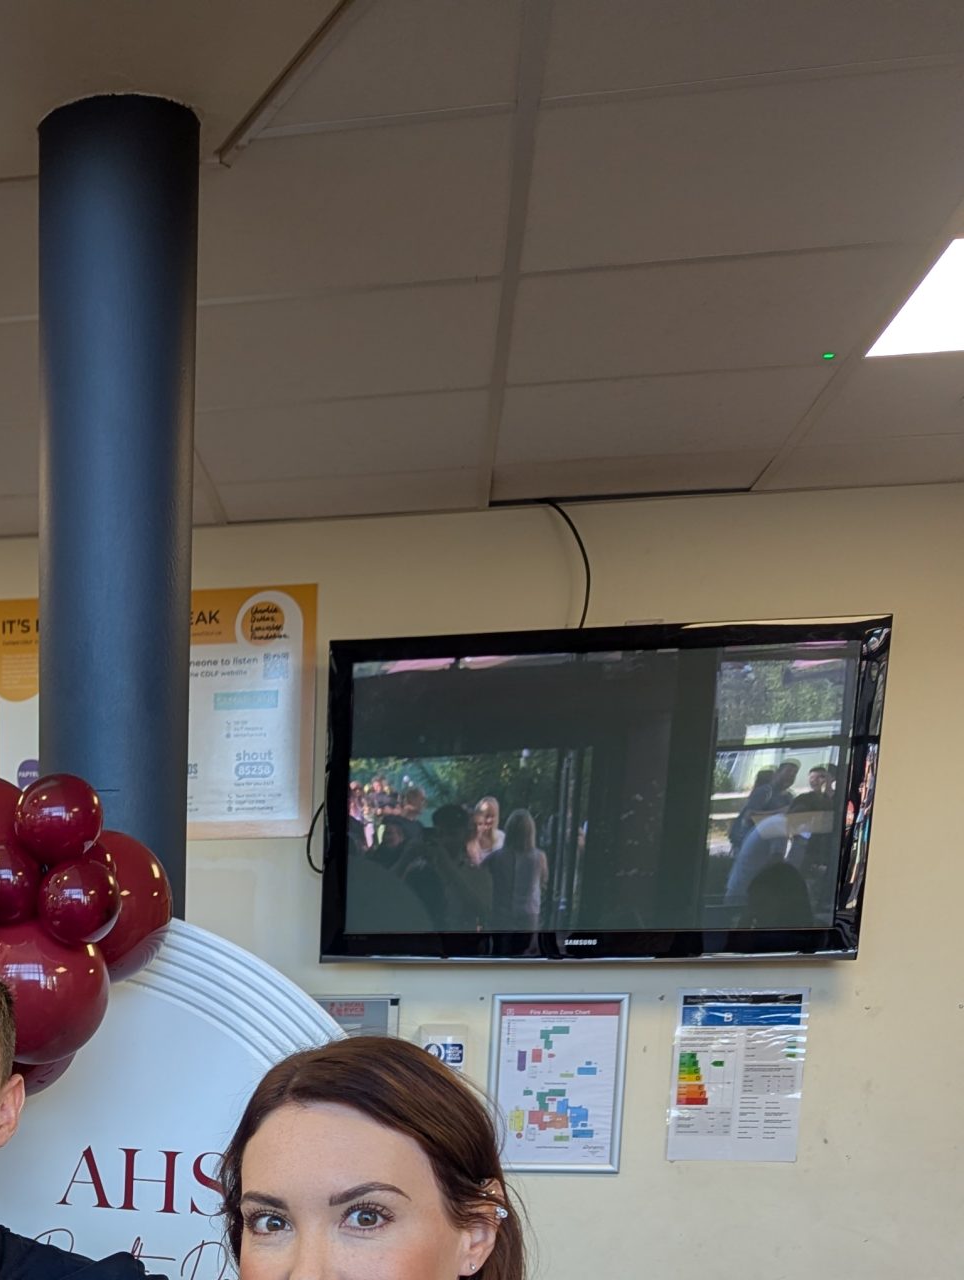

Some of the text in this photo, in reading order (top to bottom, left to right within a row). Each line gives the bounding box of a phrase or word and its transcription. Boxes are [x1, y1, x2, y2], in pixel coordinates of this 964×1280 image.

[2, 619, 31, 635] IT'S
[232, 656, 258, 666] listen
[236, 749, 273, 762] shout
[238, 764, 270, 776] 85258
[56, 1145, 227, 1217] AHS
